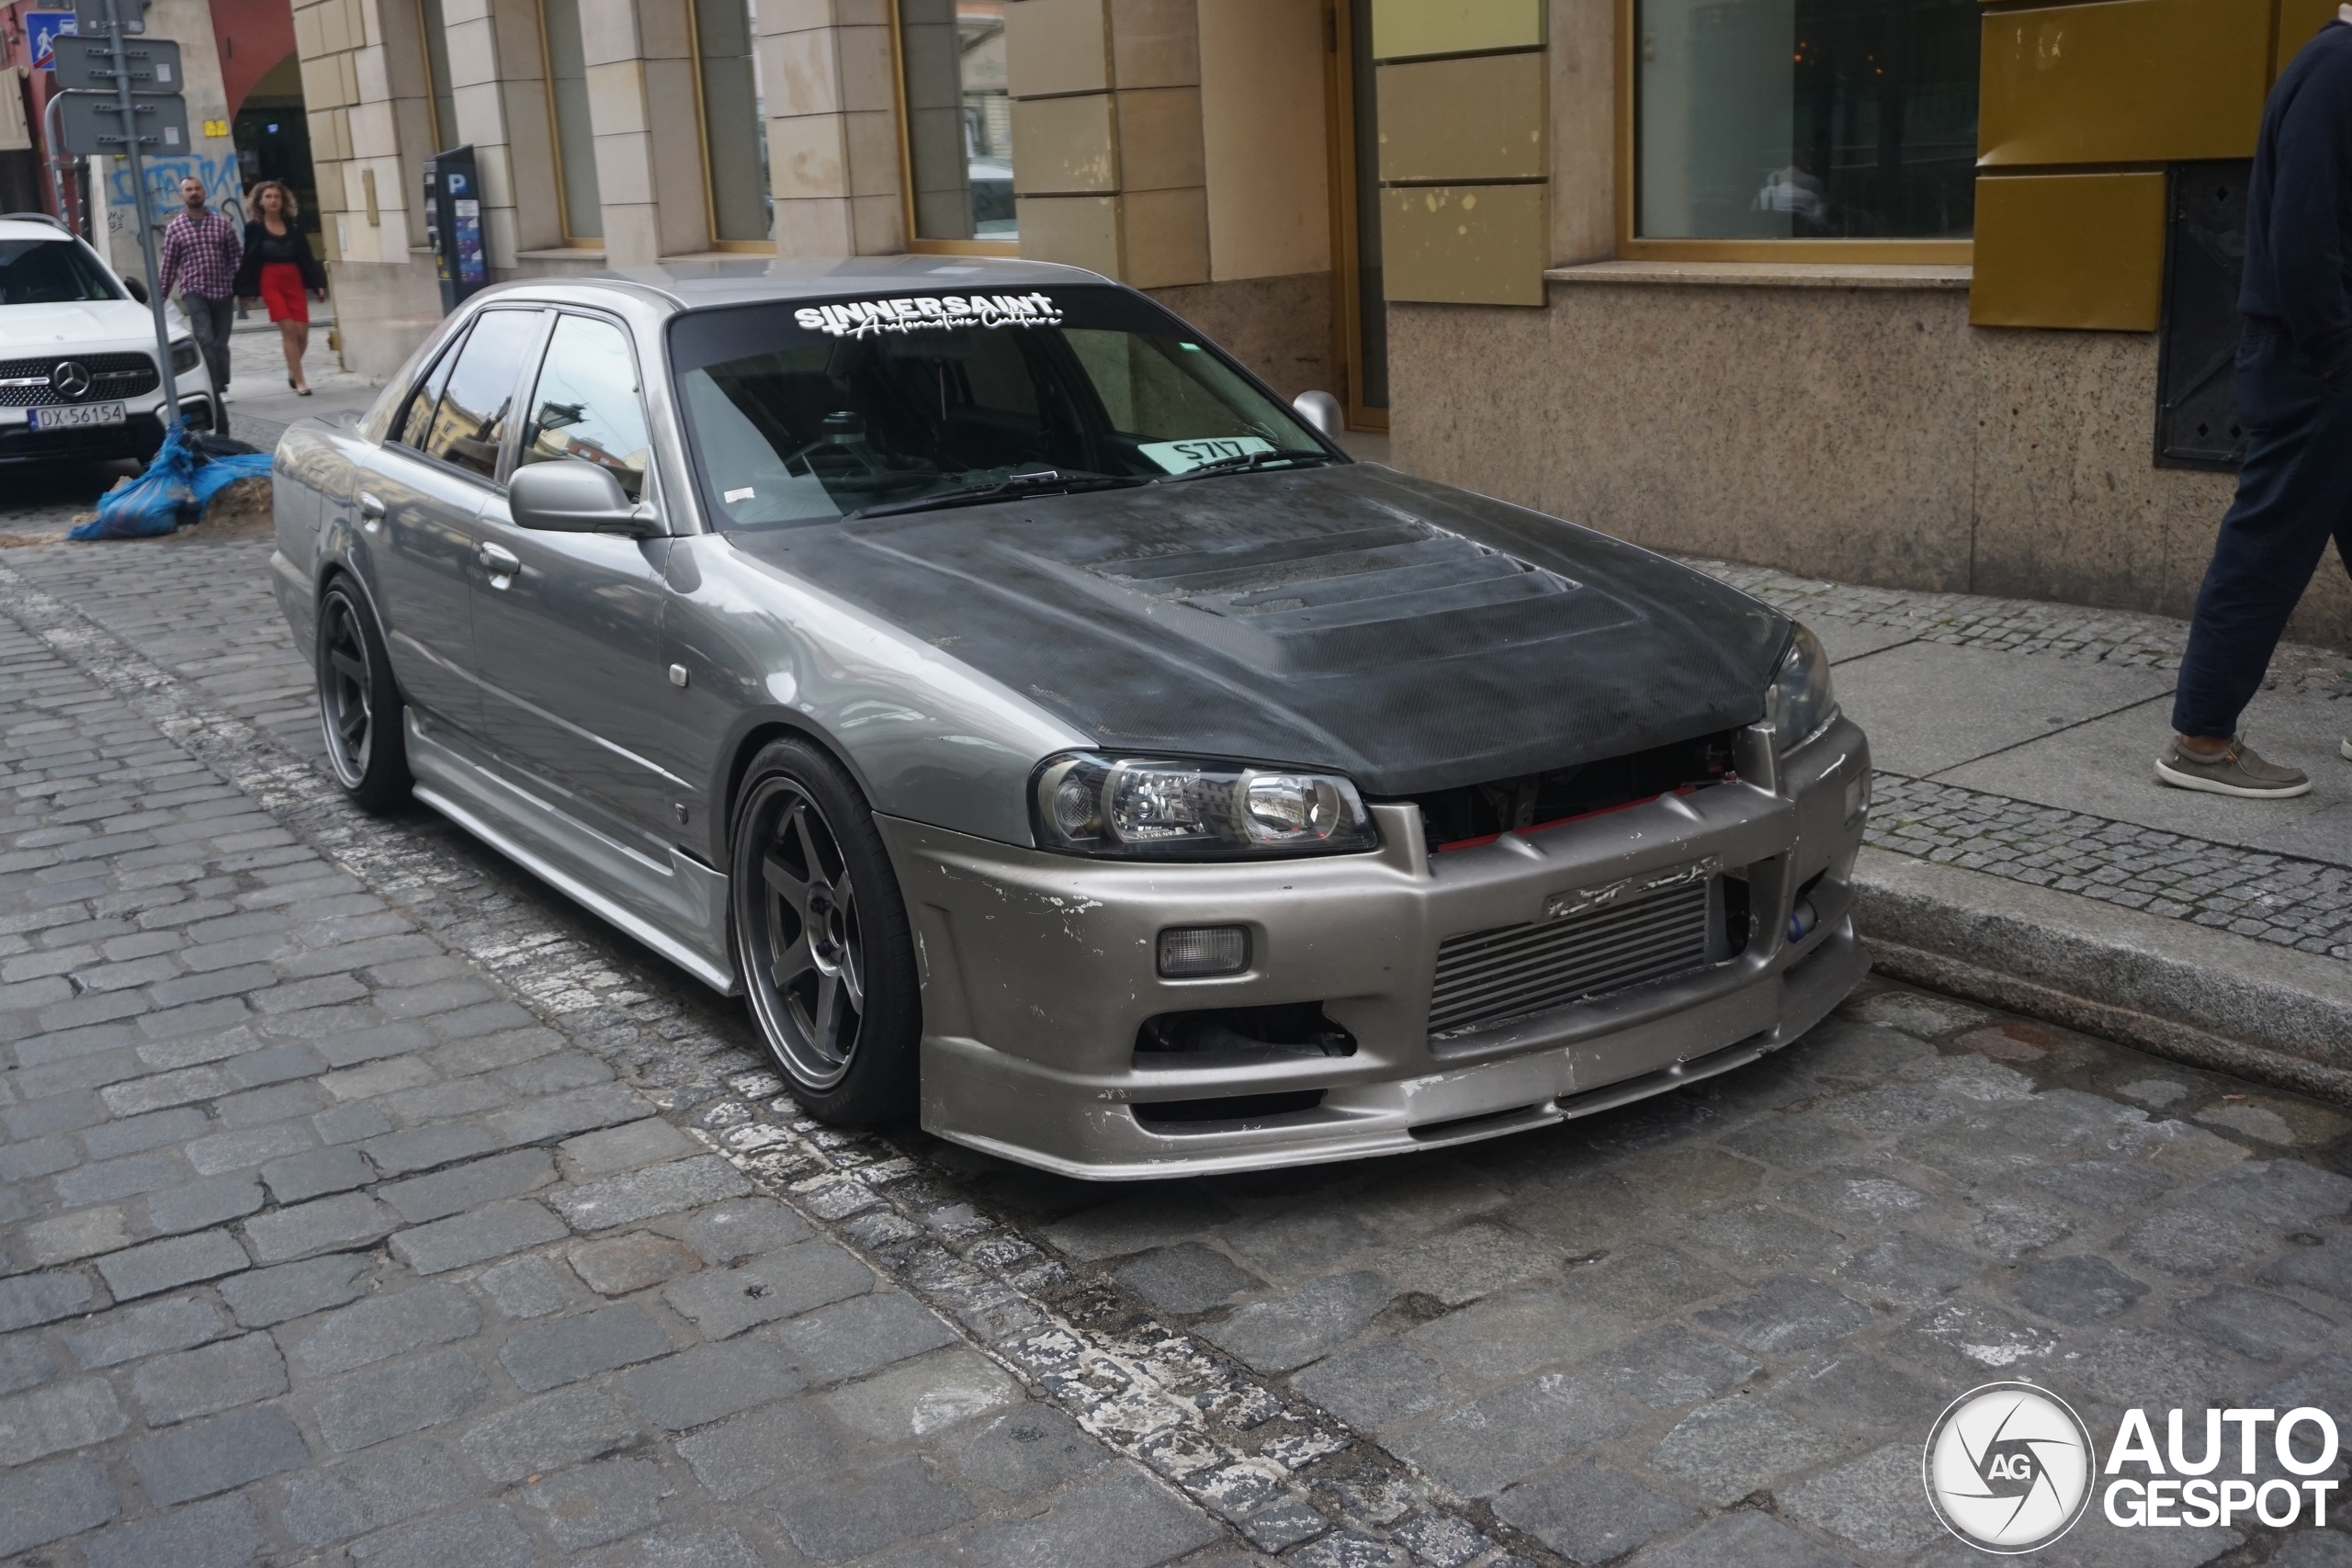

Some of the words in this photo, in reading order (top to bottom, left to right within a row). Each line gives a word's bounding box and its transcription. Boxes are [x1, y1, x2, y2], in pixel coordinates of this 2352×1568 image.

[447, 174, 467, 194] P
[846, 310, 979, 340] Automotive
[981, 308, 1062, 329] Culture
[40, 409, 64, 426] DX
[70, 405, 122, 423] 56154
[1172, 440, 1246, 460] S717
